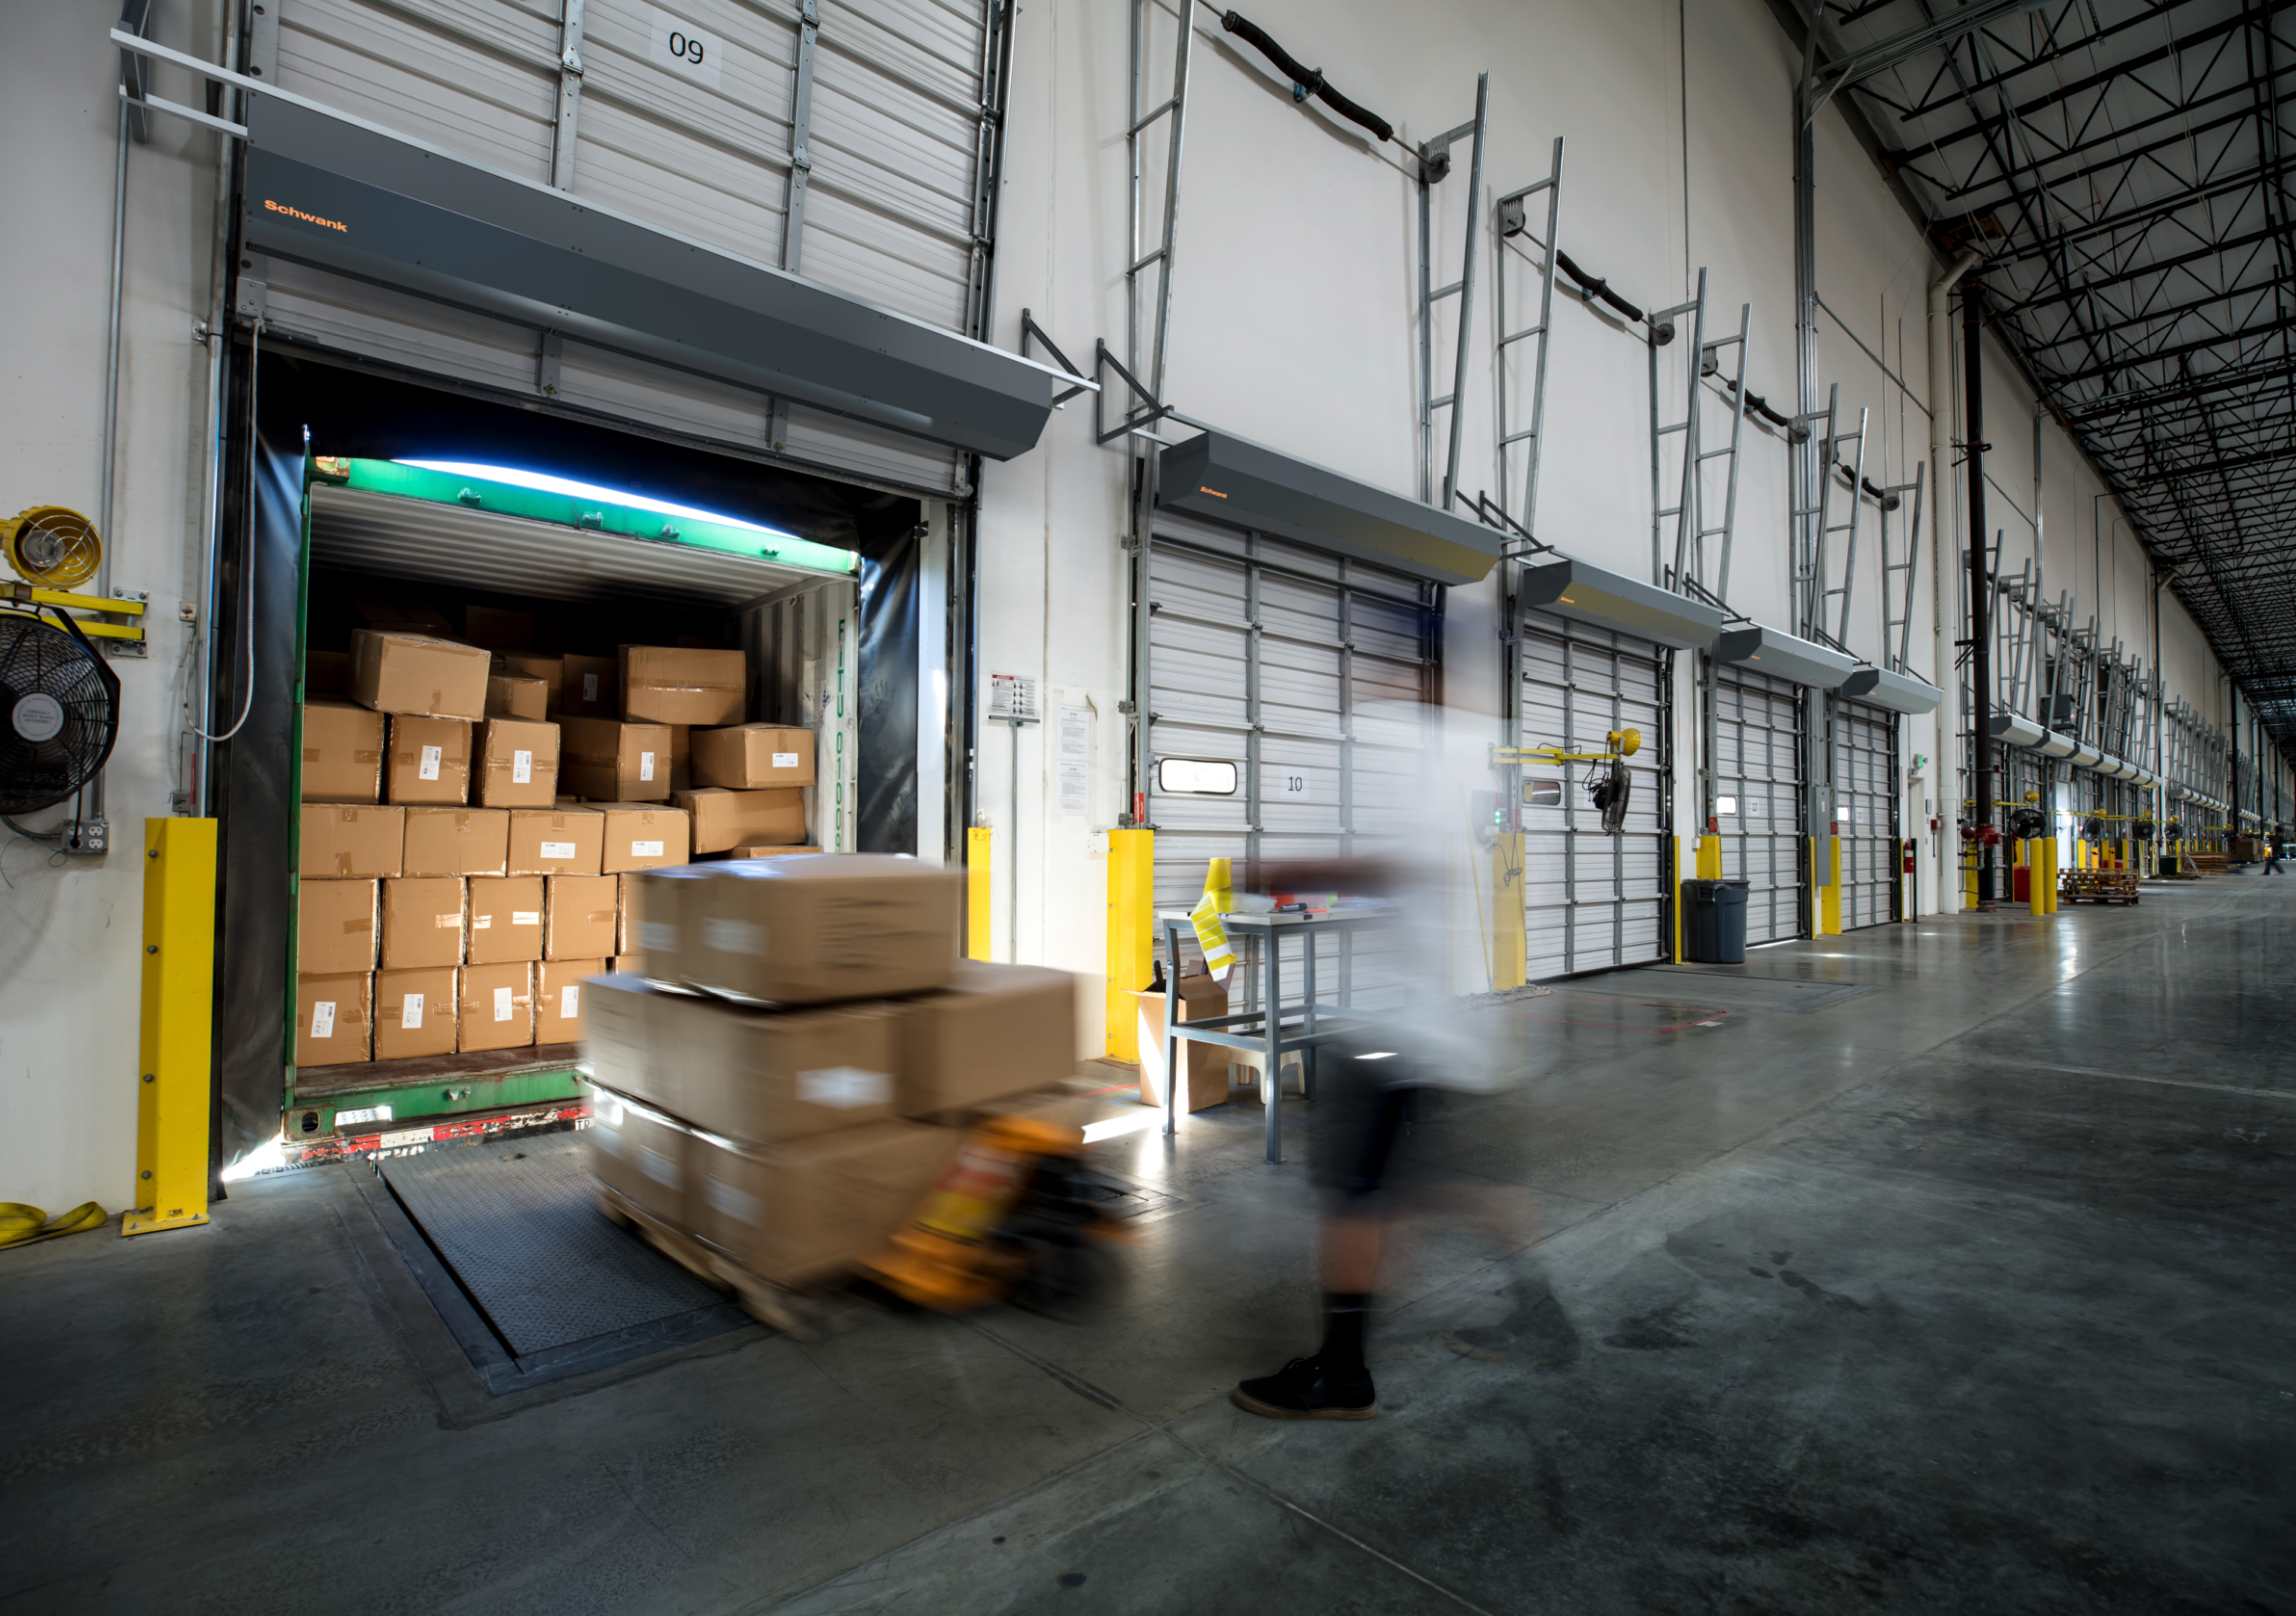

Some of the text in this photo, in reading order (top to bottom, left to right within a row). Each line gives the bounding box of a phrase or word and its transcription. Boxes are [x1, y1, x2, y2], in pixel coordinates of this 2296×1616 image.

[669, 31, 704, 65] 09
[264, 199, 348, 233] Schwank
[1287, 776, 1303, 792] 10
